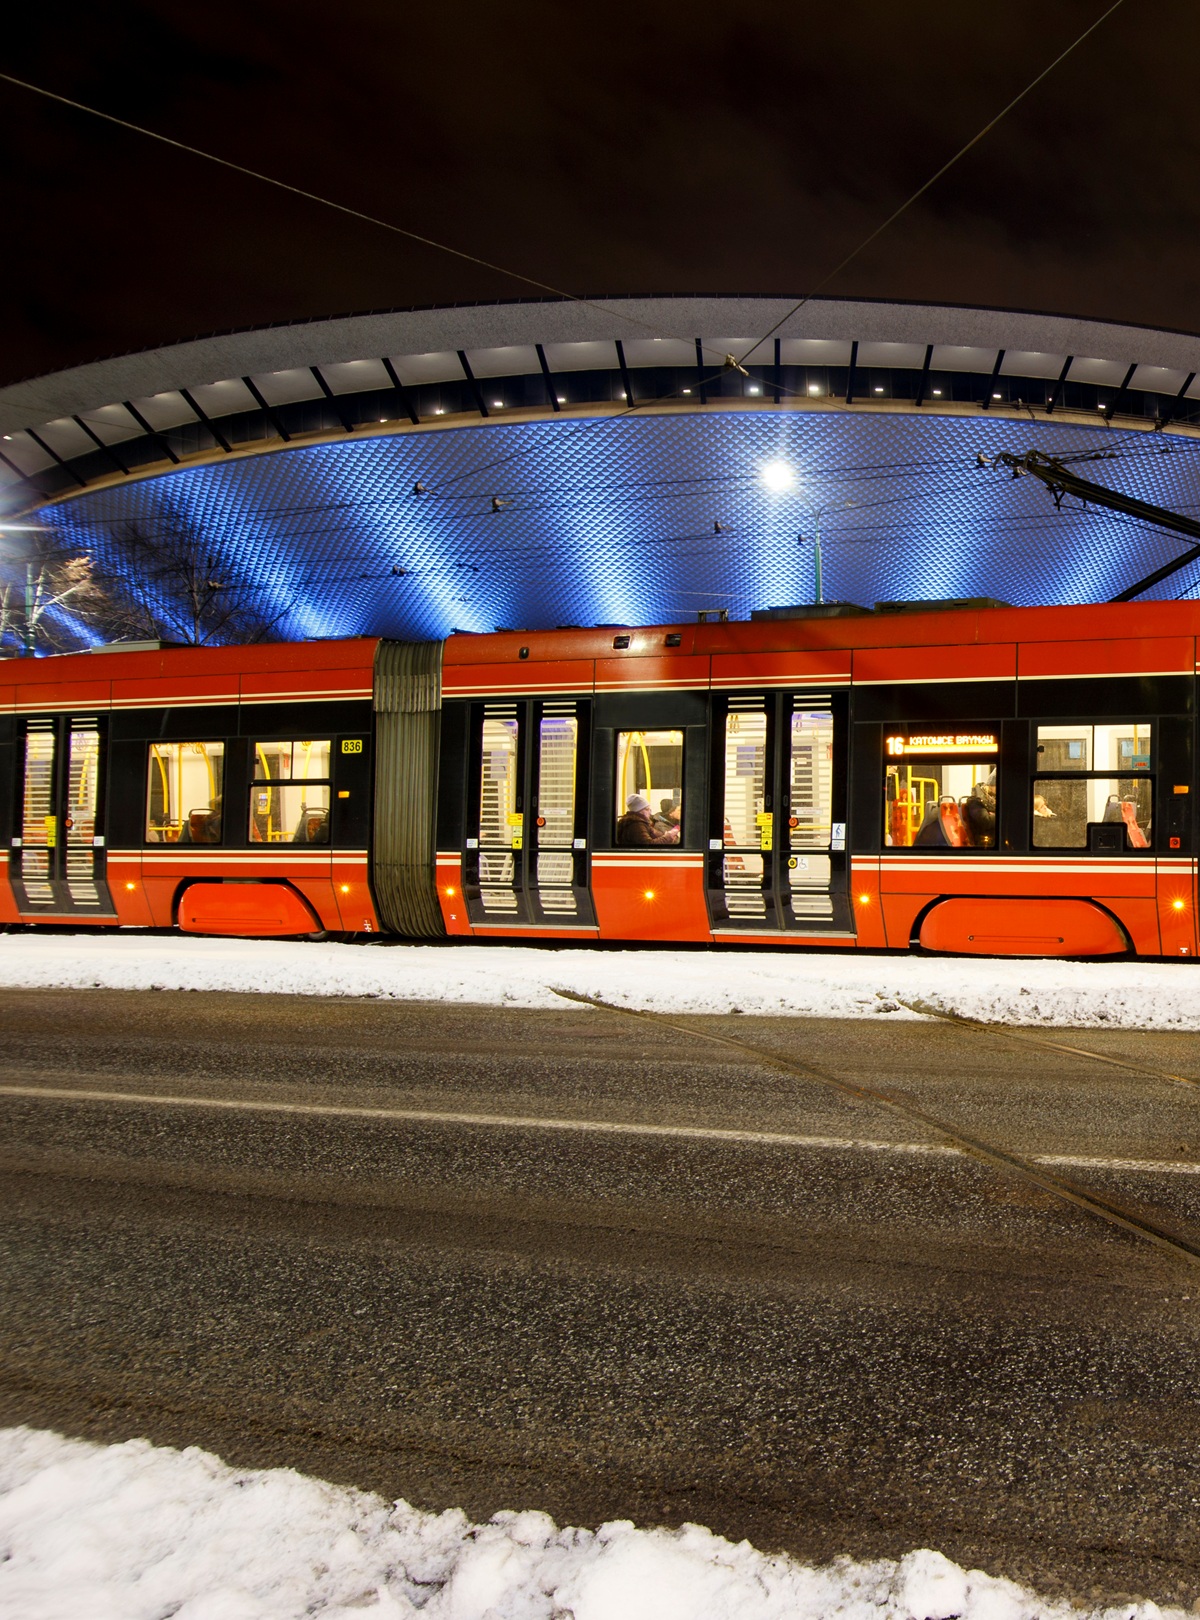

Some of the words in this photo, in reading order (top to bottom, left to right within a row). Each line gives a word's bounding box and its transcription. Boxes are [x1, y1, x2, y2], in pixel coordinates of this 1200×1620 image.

[886, 736, 904, 755] 16
[909, 736, 954, 745] KATOWICE
[344, 741, 360, 751] 836
